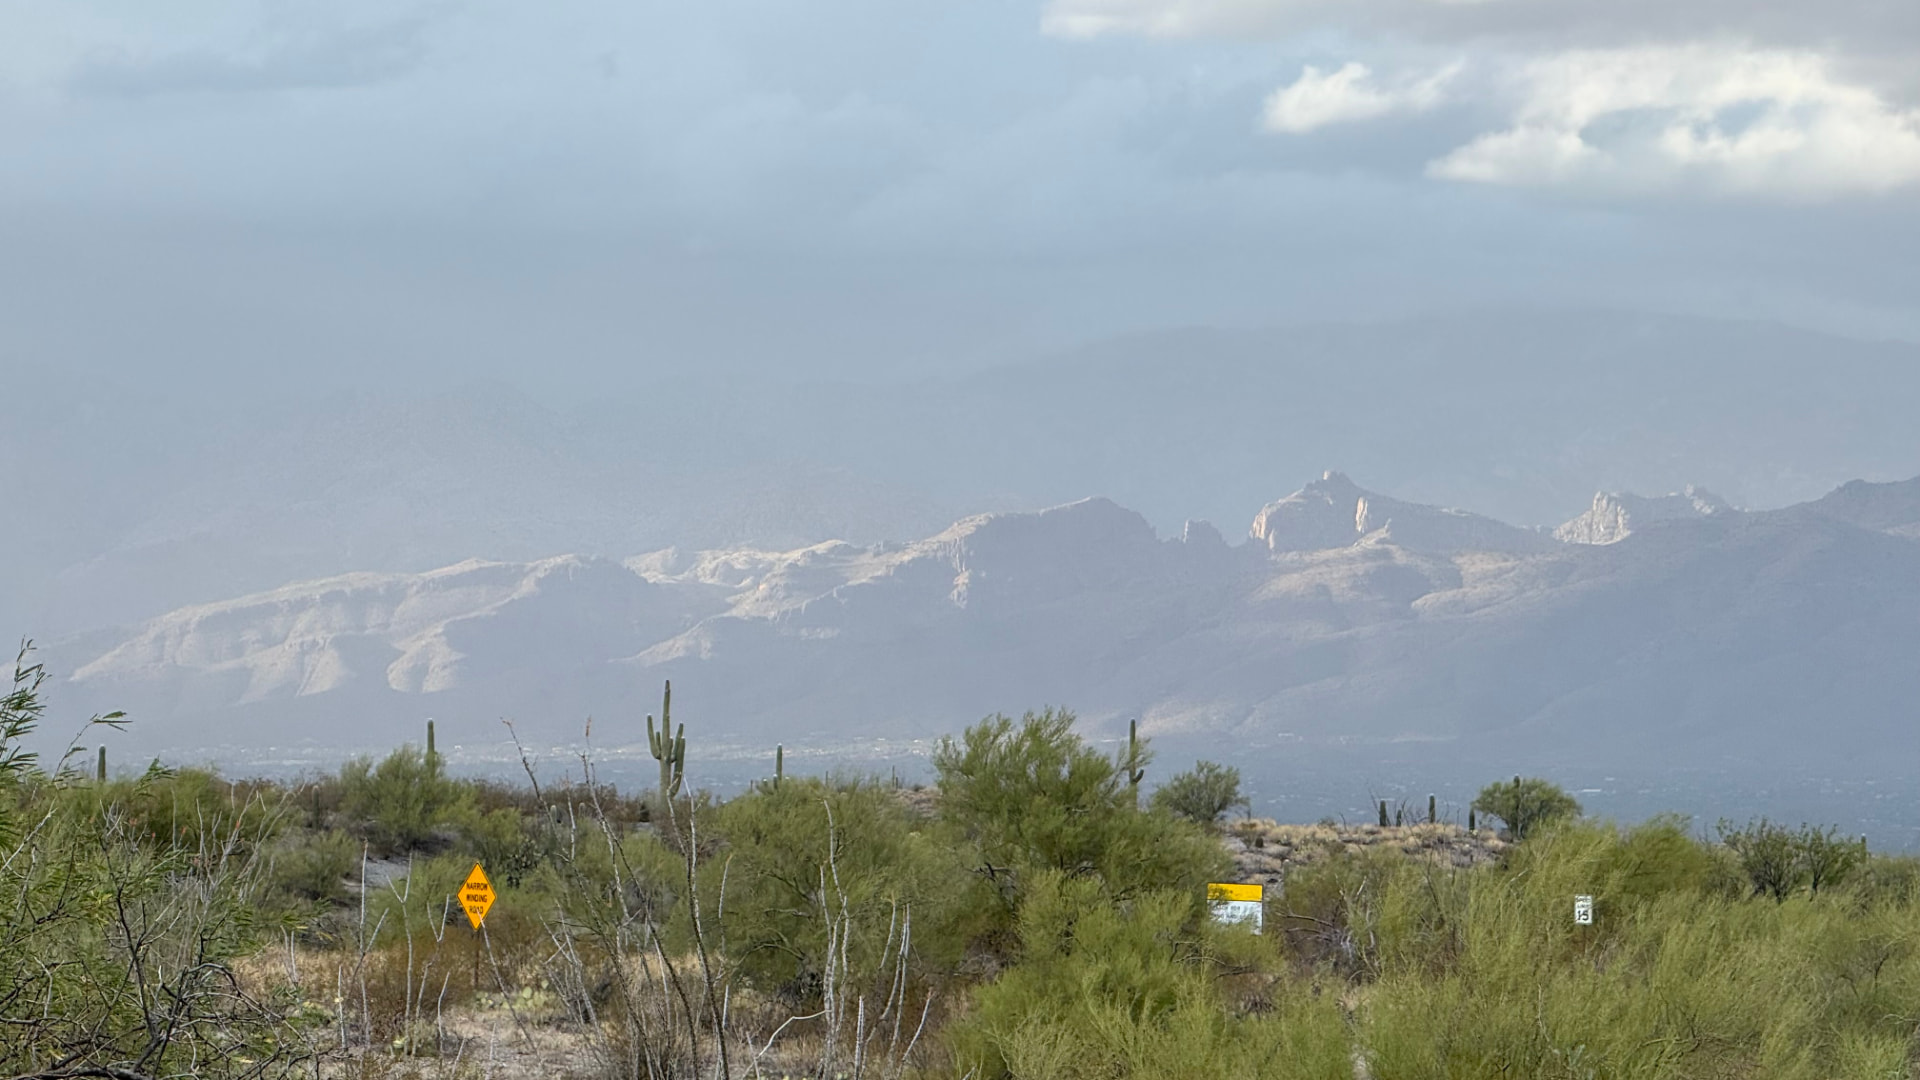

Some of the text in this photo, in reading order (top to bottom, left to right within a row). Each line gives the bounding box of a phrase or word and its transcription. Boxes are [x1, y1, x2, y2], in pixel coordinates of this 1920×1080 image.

[466, 883, 488, 891] NARROW
[466, 894, 488, 903] WINDING
[1578, 910, 1589, 921] 15
